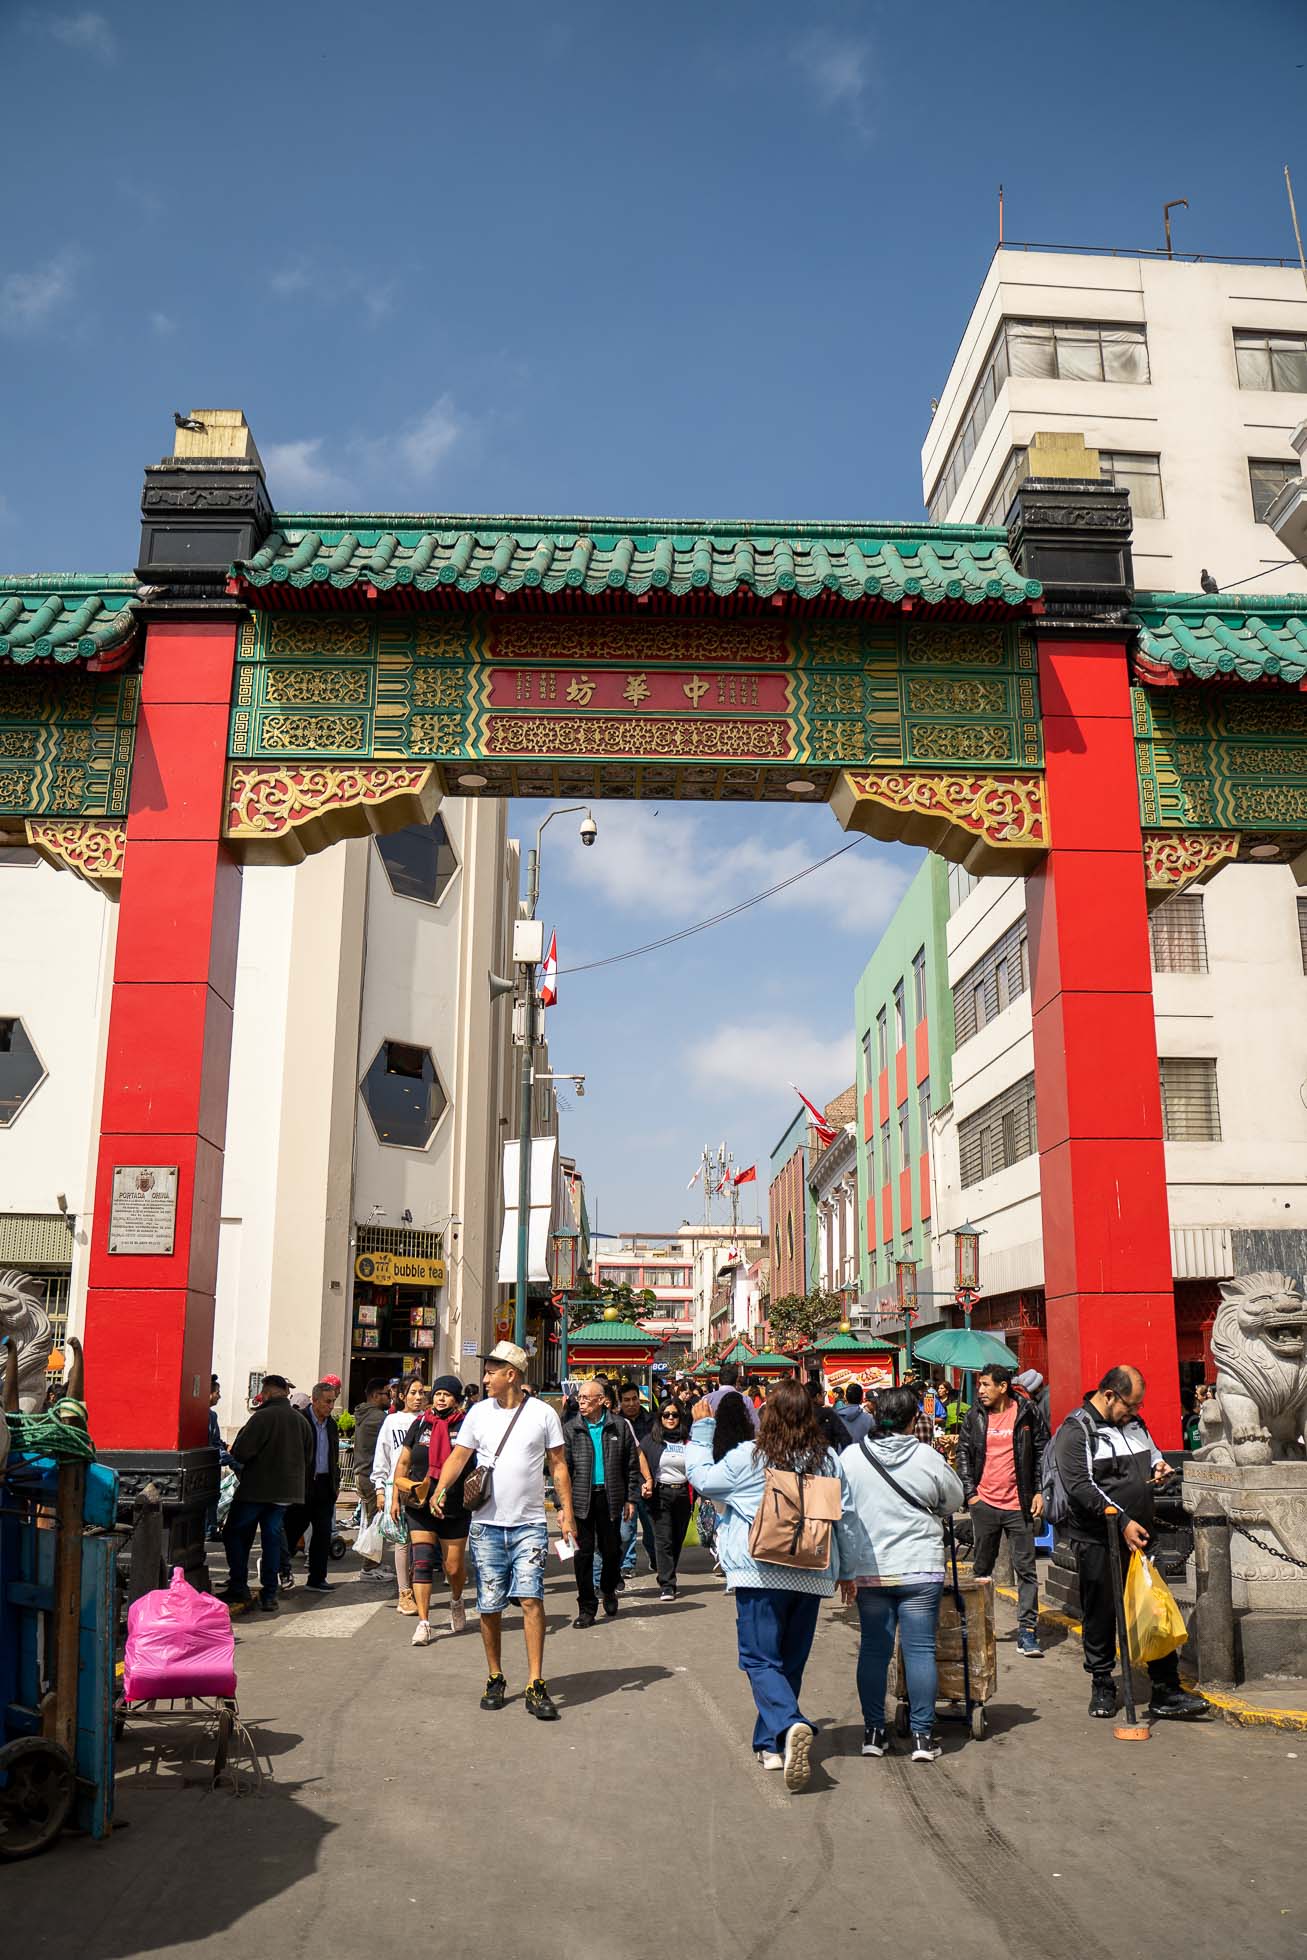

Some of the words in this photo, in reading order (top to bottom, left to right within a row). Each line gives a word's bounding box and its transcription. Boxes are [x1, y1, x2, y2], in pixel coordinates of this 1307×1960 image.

[375, 1261, 390, 1272] 777
[393, 1263, 426, 1278] bubble
[428, 1265, 444, 1279] tea
